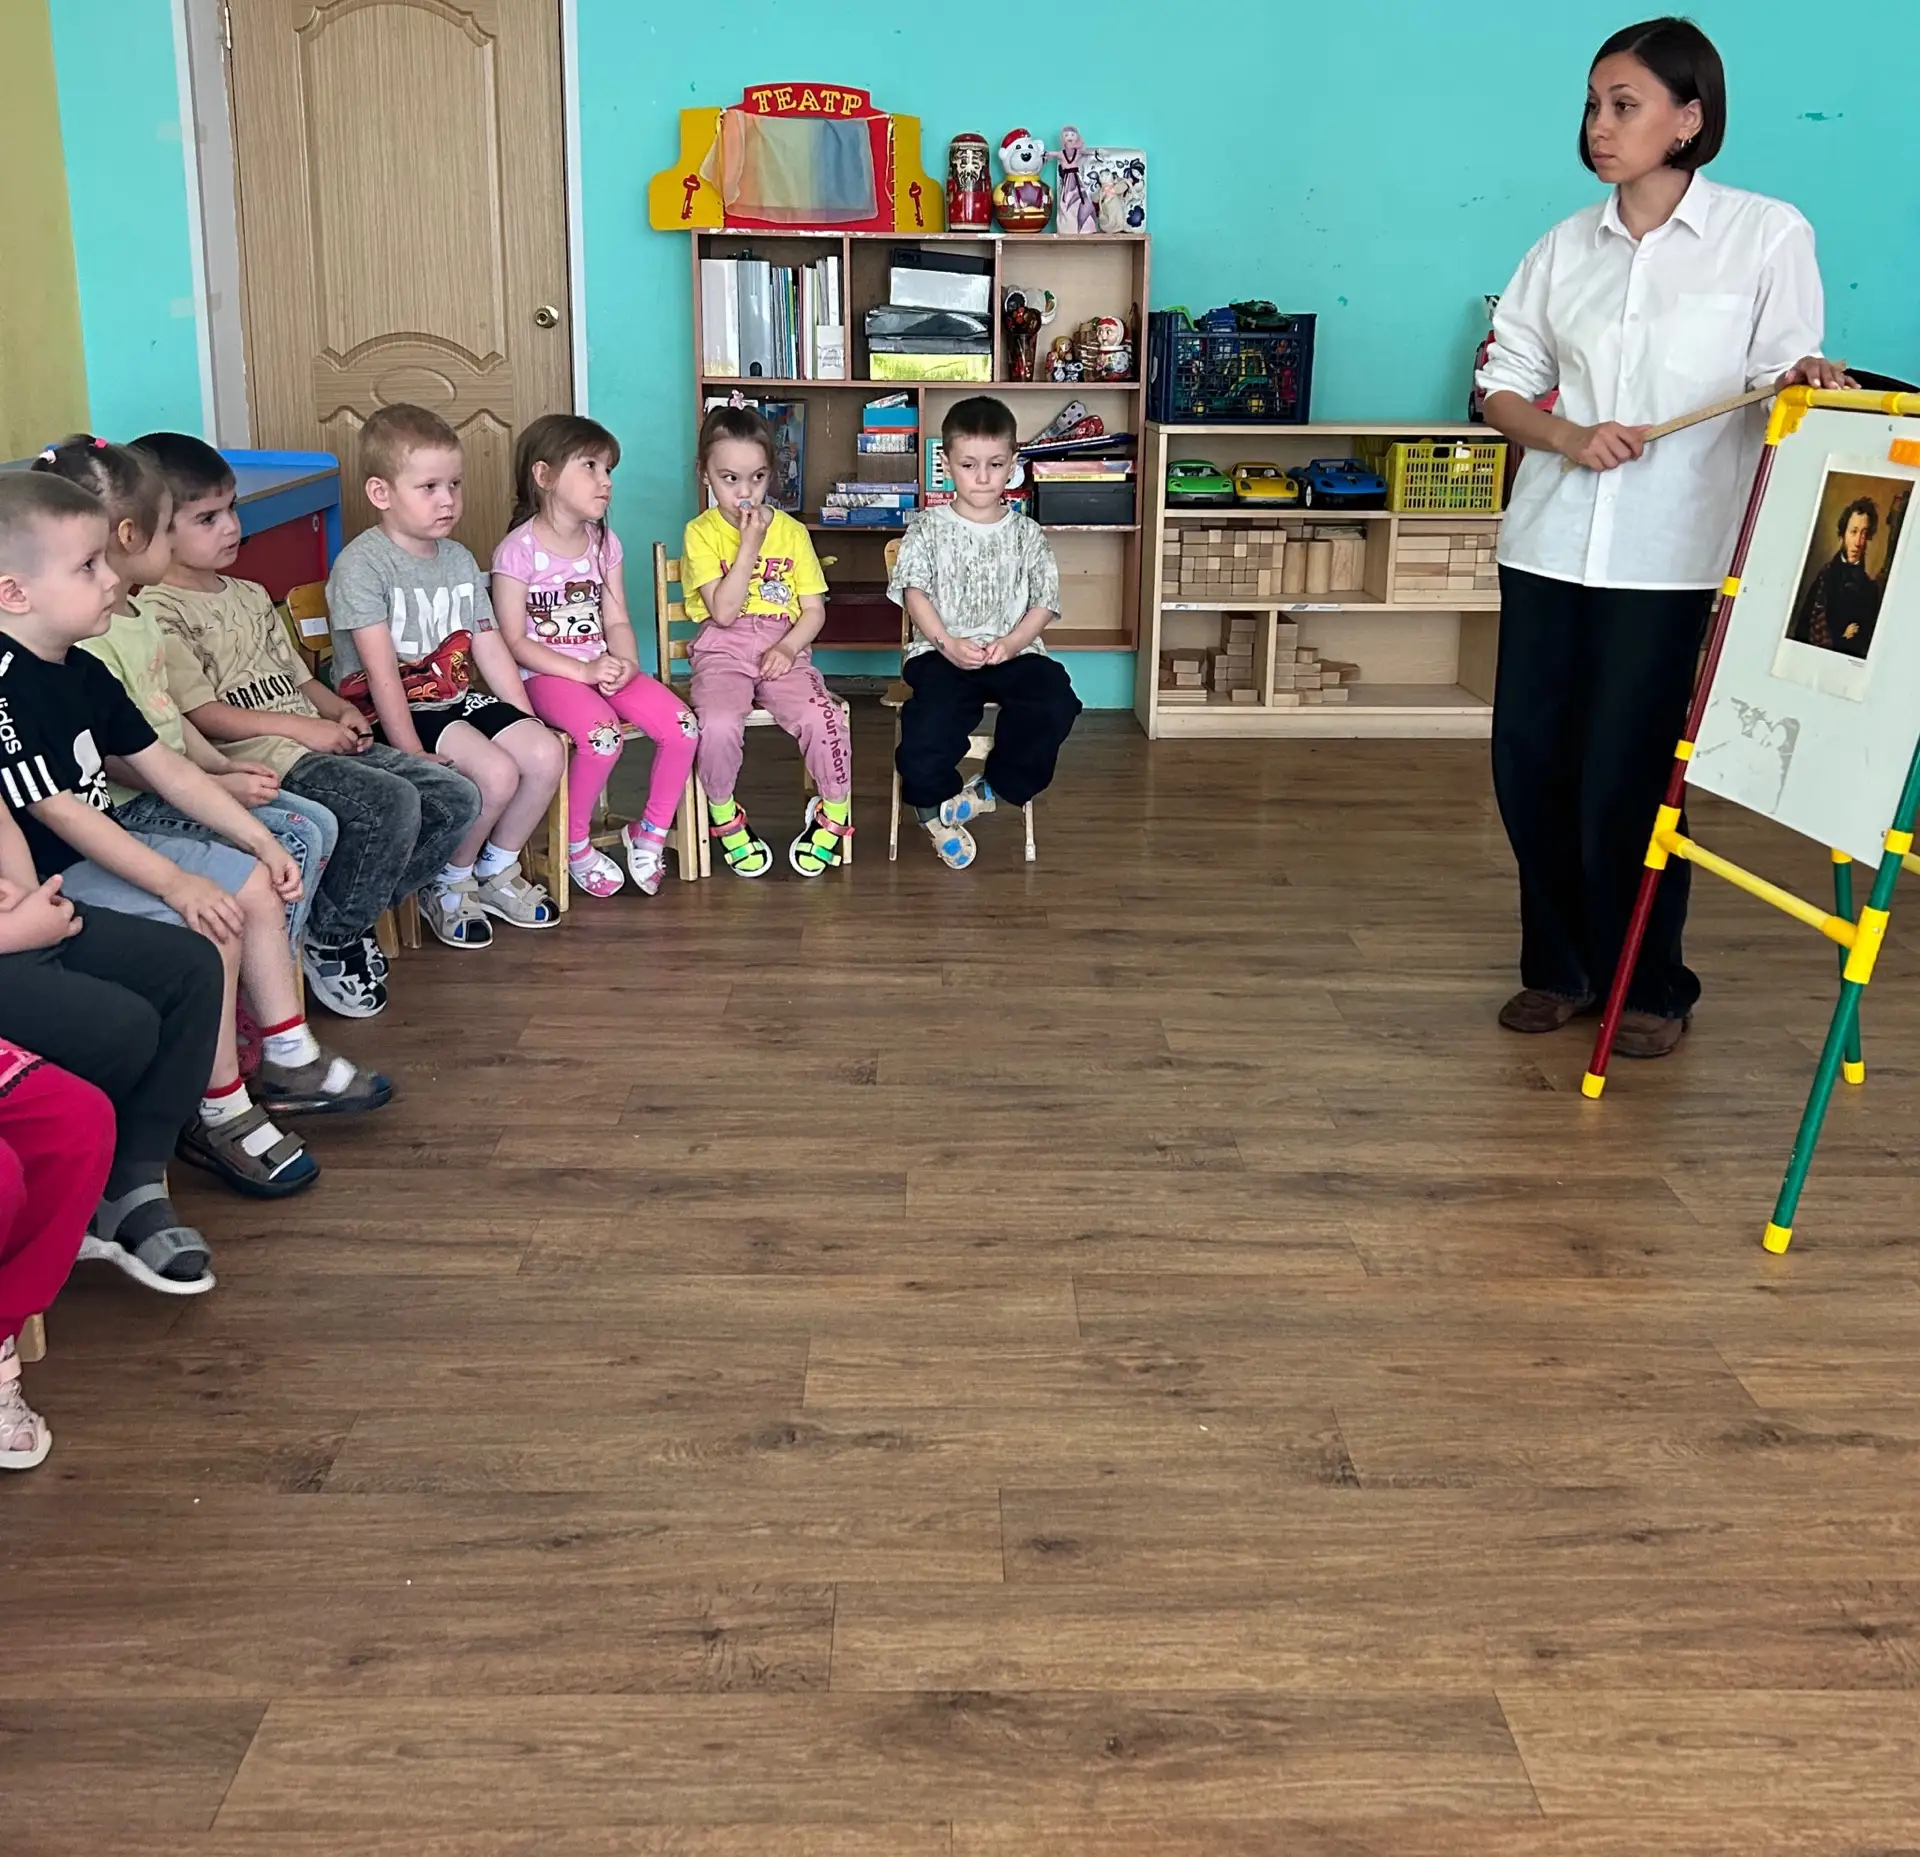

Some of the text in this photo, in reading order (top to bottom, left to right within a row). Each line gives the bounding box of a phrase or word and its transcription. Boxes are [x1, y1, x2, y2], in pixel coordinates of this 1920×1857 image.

[752, 86, 862, 115] ТЕАТР
[0, 697, 23, 755] idas
[817, 700, 838, 737] your
